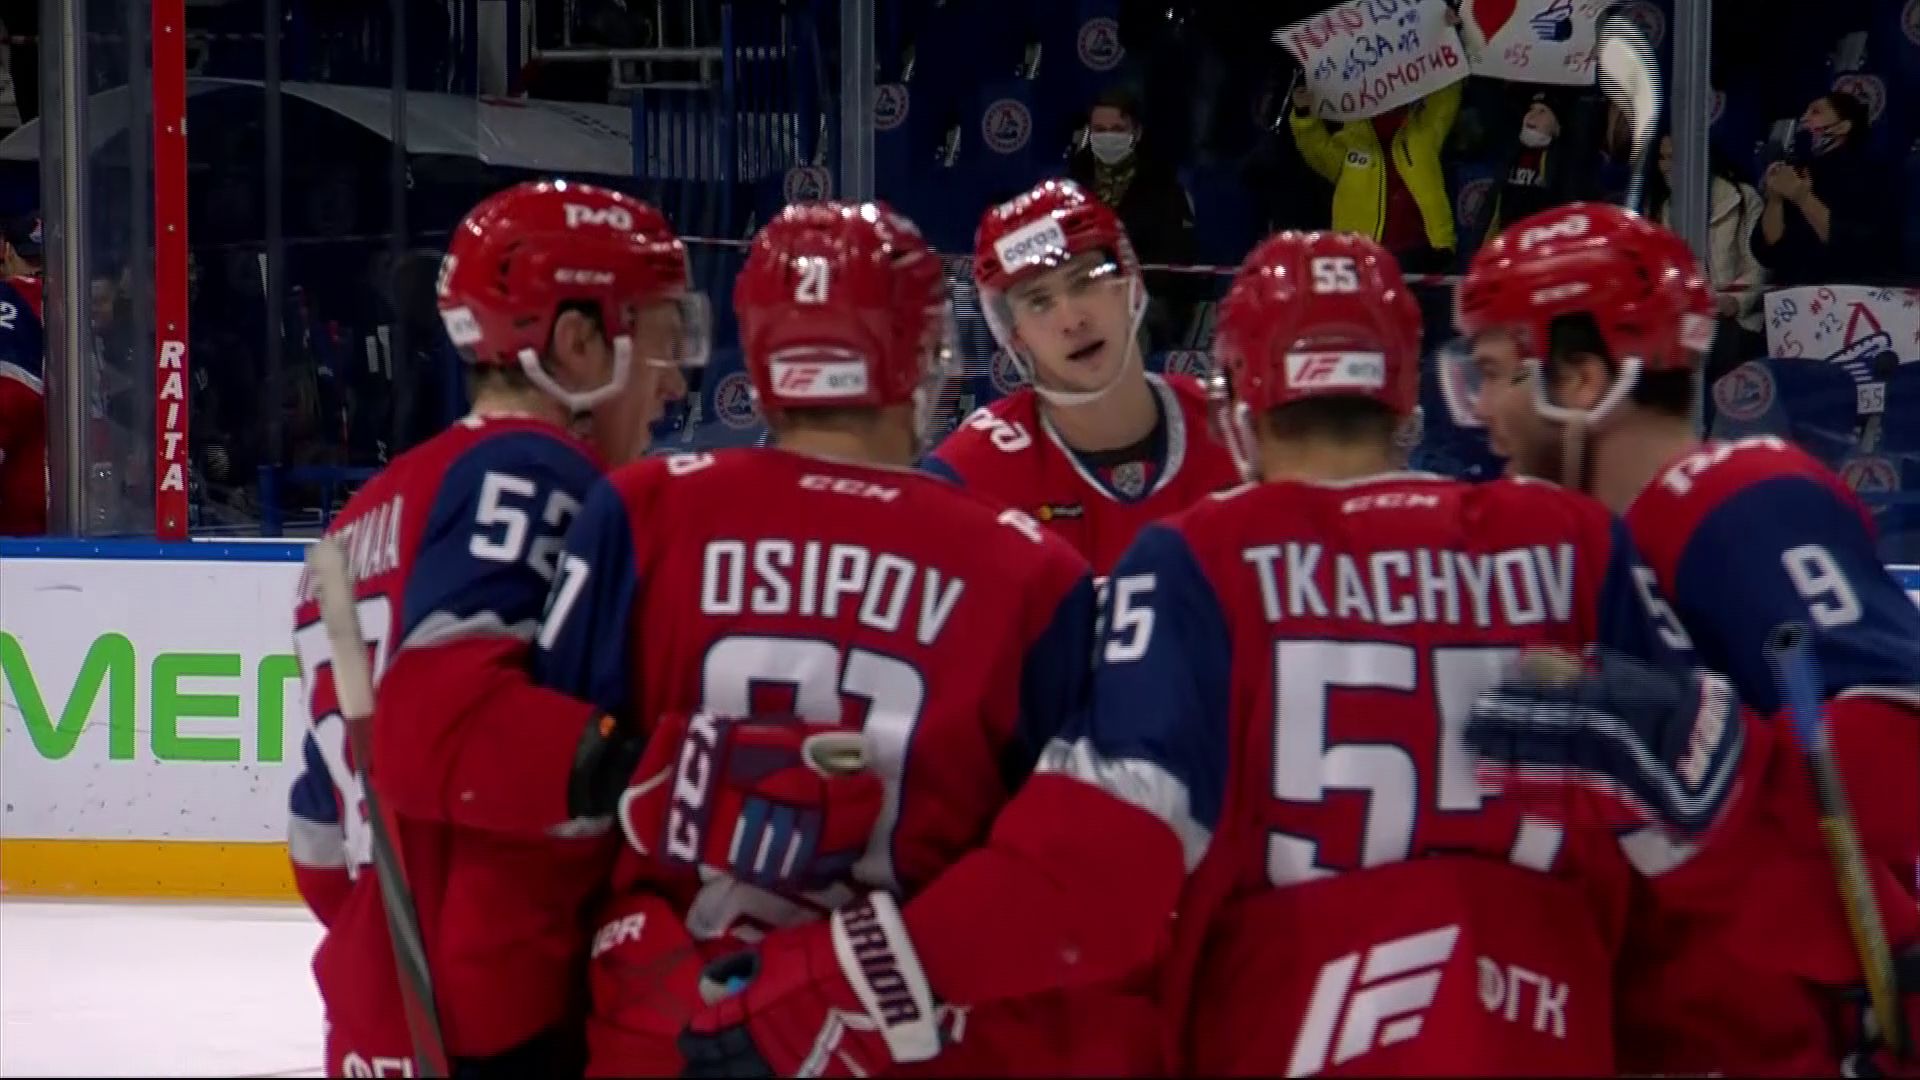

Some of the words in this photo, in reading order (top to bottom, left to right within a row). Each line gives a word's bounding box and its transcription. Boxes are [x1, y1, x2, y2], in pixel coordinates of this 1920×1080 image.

[794, 256, 829, 304] 21
[1311, 256, 1358, 294] 55
[159, 340, 186, 492] RAITA
[701, 539, 964, 645] OSIPOV
[1243, 541, 1575, 627] TKACHYOV
[1781, 545, 1863, 628] 9
[1477, 957, 1570, 1038] ФГК
